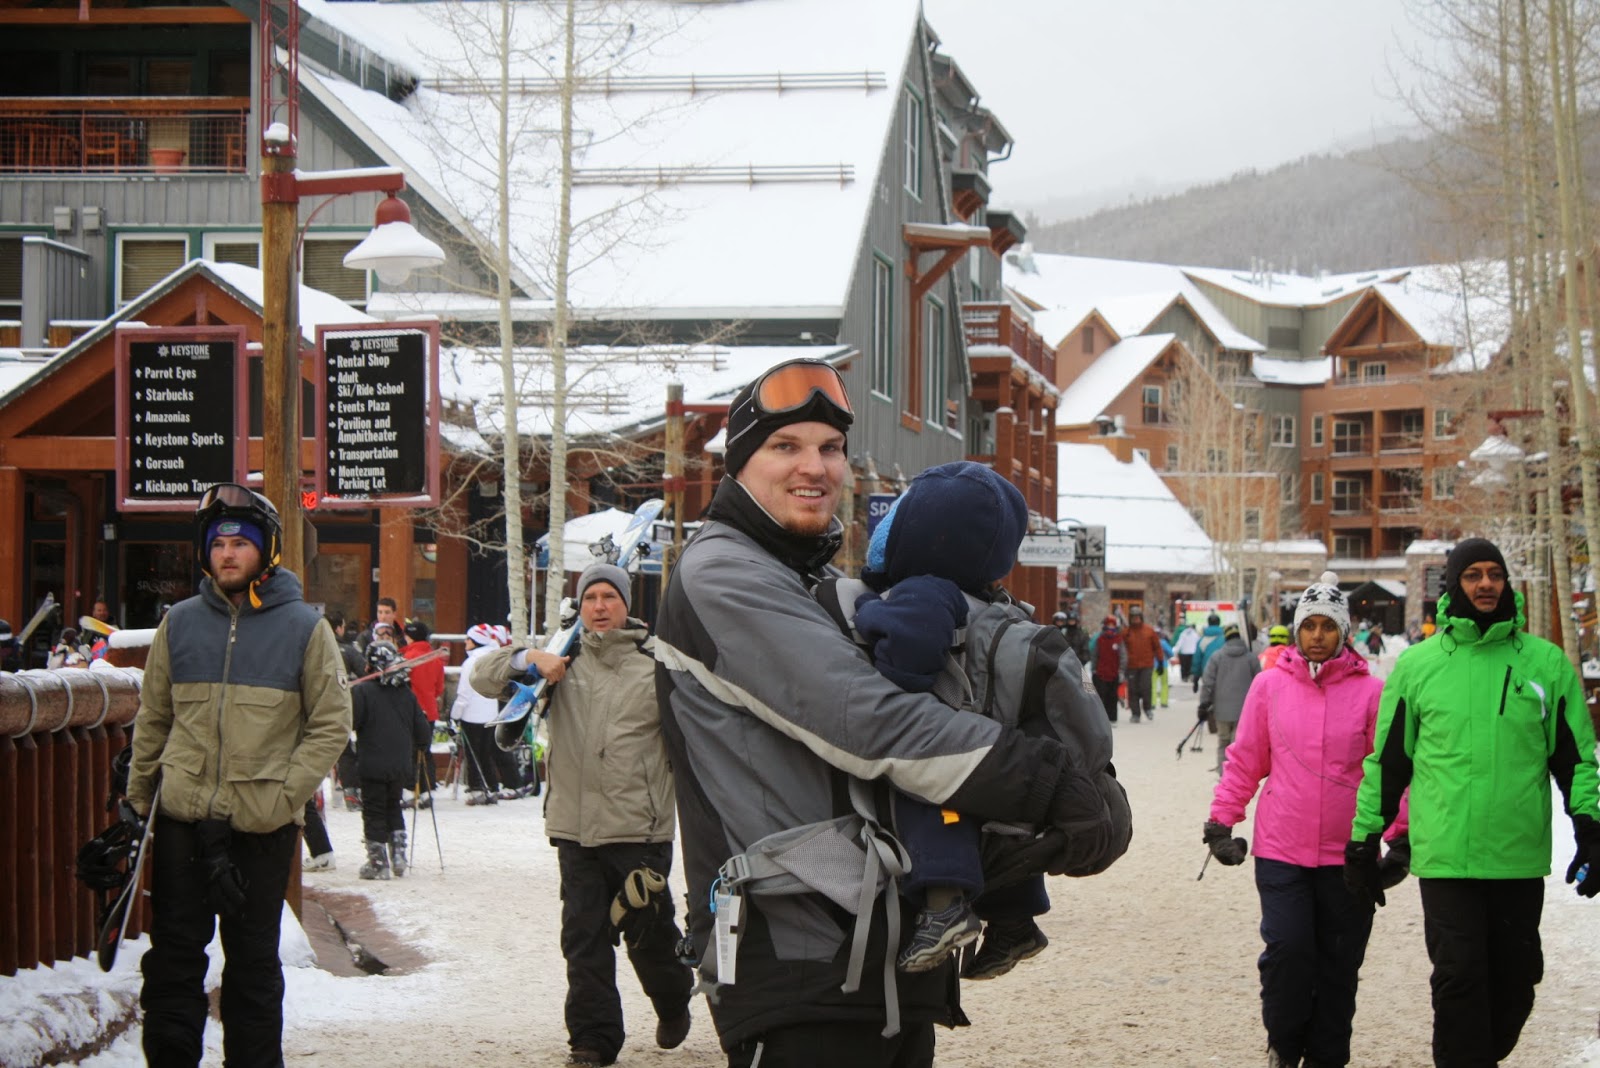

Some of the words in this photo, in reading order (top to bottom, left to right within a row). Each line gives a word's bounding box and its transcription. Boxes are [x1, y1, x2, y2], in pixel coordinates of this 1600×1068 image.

[171, 344, 210, 356] KEYSTONE
[362, 337, 399, 350] KEYSTONE
[337, 354, 366, 368] Rental
[368, 354, 390, 368] Shop
[144, 366, 174, 379] Parrot
[176, 367, 197, 380] Eyes
[337, 371, 359, 384] Adult
[145, 388, 194, 401] Starbucks
[337, 384, 374, 398] Ski/Ride
[376, 382, 405, 396] School
[337, 401, 366, 414] Events
[367, 399, 391, 412] Plaza
[145, 411, 190, 423] Amazonias
[337, 417, 372, 430] Pavilion
[374, 415, 391, 429] and
[145, 433, 189, 448] Keystone
[192, 432, 224, 447] Sports
[337, 430, 398, 445] Amphitheater
[338, 448, 399, 462] Transportation
[145, 457, 185, 470] Gorsuch
[338, 465, 386, 478] Montezuma
[145, 480, 189, 493] Kickapoo
[338, 477, 370, 491] Parking
[372, 476, 387, 489] Lot
[869, 501, 894, 517] SP
